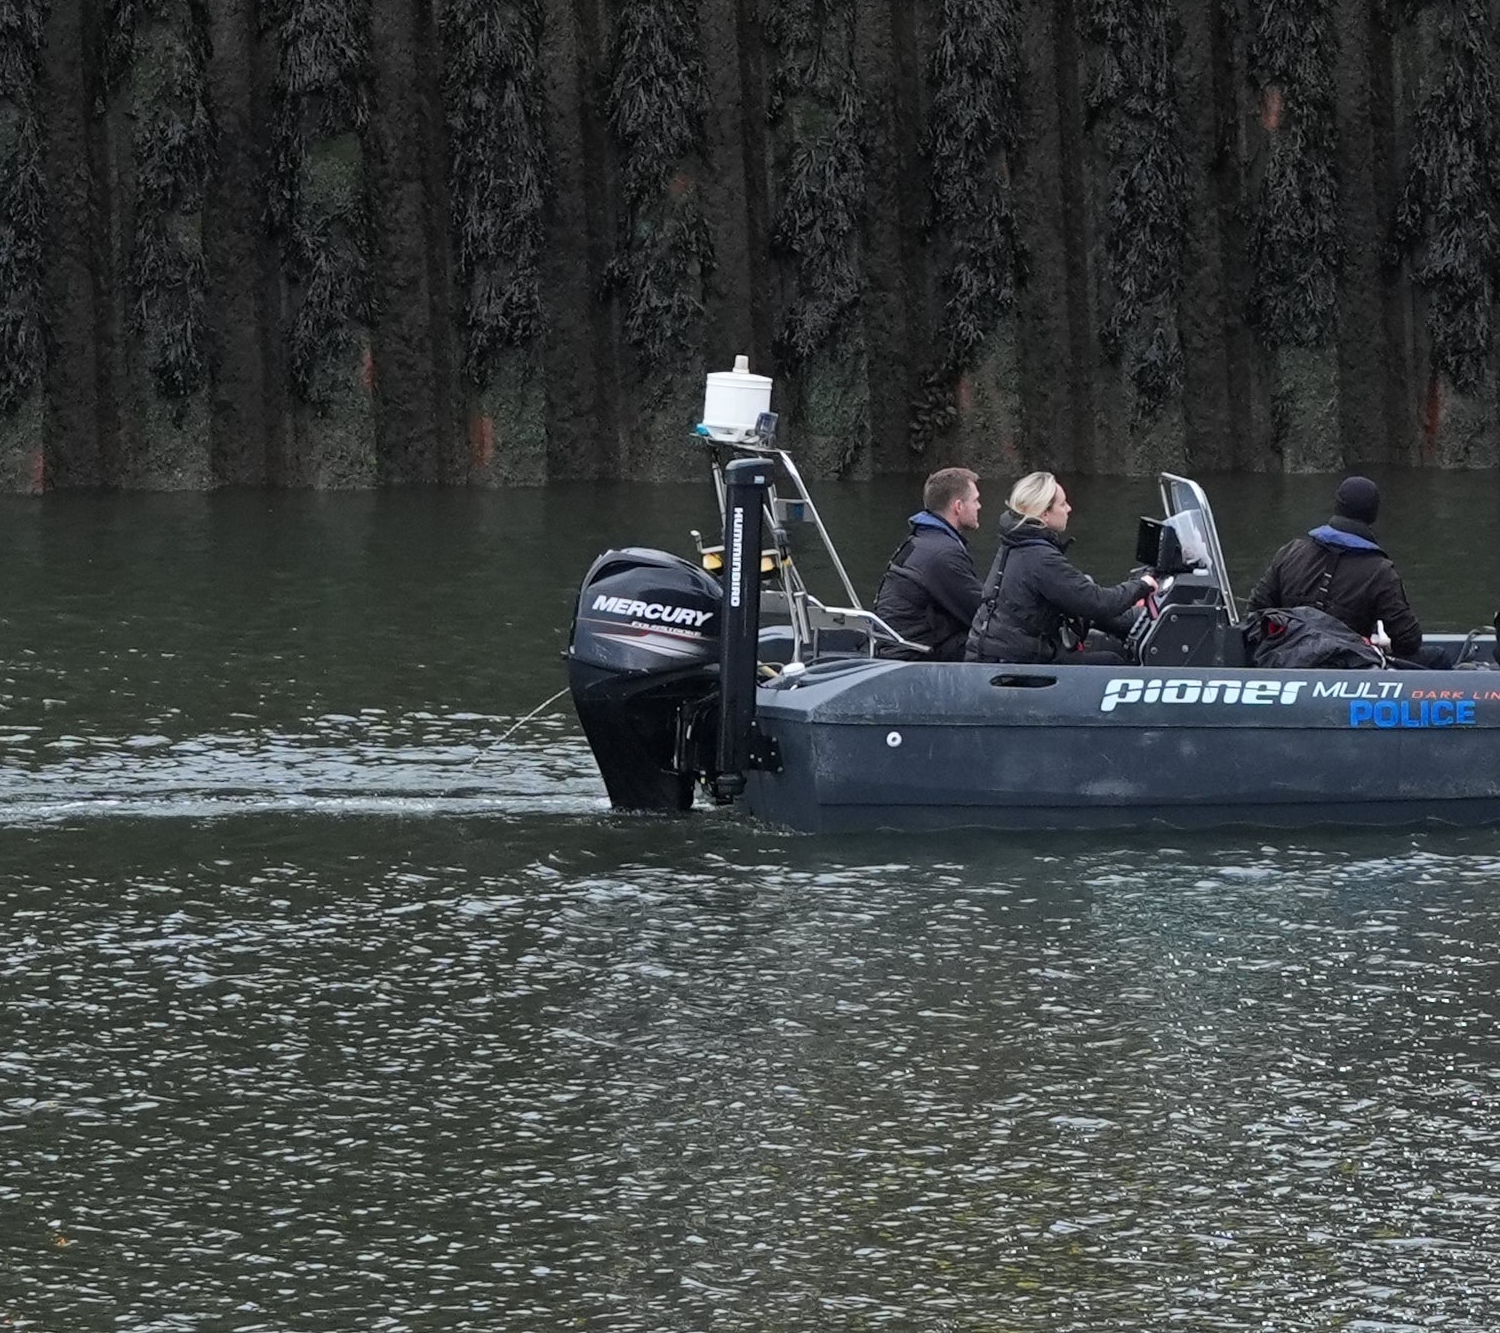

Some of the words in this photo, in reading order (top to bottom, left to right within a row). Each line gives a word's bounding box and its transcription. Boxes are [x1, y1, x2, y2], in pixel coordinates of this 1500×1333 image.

[730, 507, 744, 607] HUMMINBIRD
[592, 594, 714, 626] MERCURY
[1312, 681, 1404, 699] MULTI
[1411, 690, 1469, 700] DARK
[1349, 699, 1477, 729] POLICE
